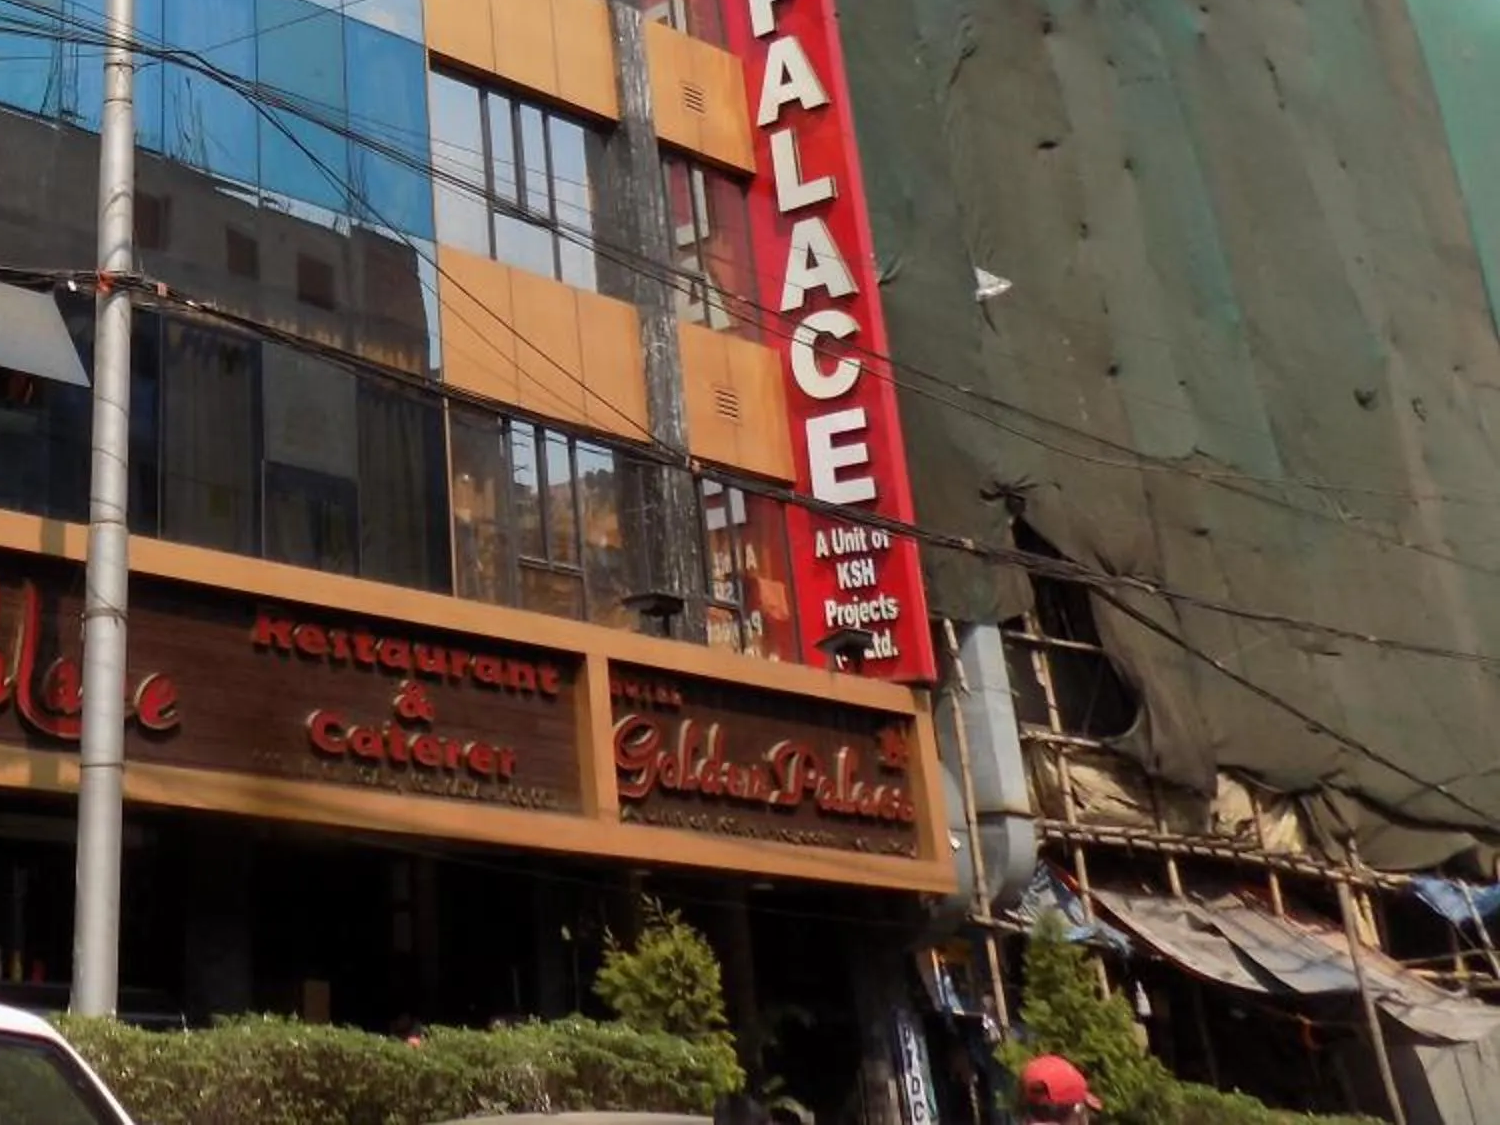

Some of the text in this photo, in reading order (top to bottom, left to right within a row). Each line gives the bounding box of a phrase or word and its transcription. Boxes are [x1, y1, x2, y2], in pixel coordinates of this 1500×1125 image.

[815, 530, 829, 559] A
[831, 526, 869, 555] Unit
[836, 557, 877, 590] KSH
[824, 592, 900, 629] Projects
[253, 613, 560, 694] Restaurant
[393, 679, 436, 722] &
[306, 708, 518, 777] Caterer
[613, 713, 773, 802] Golden
